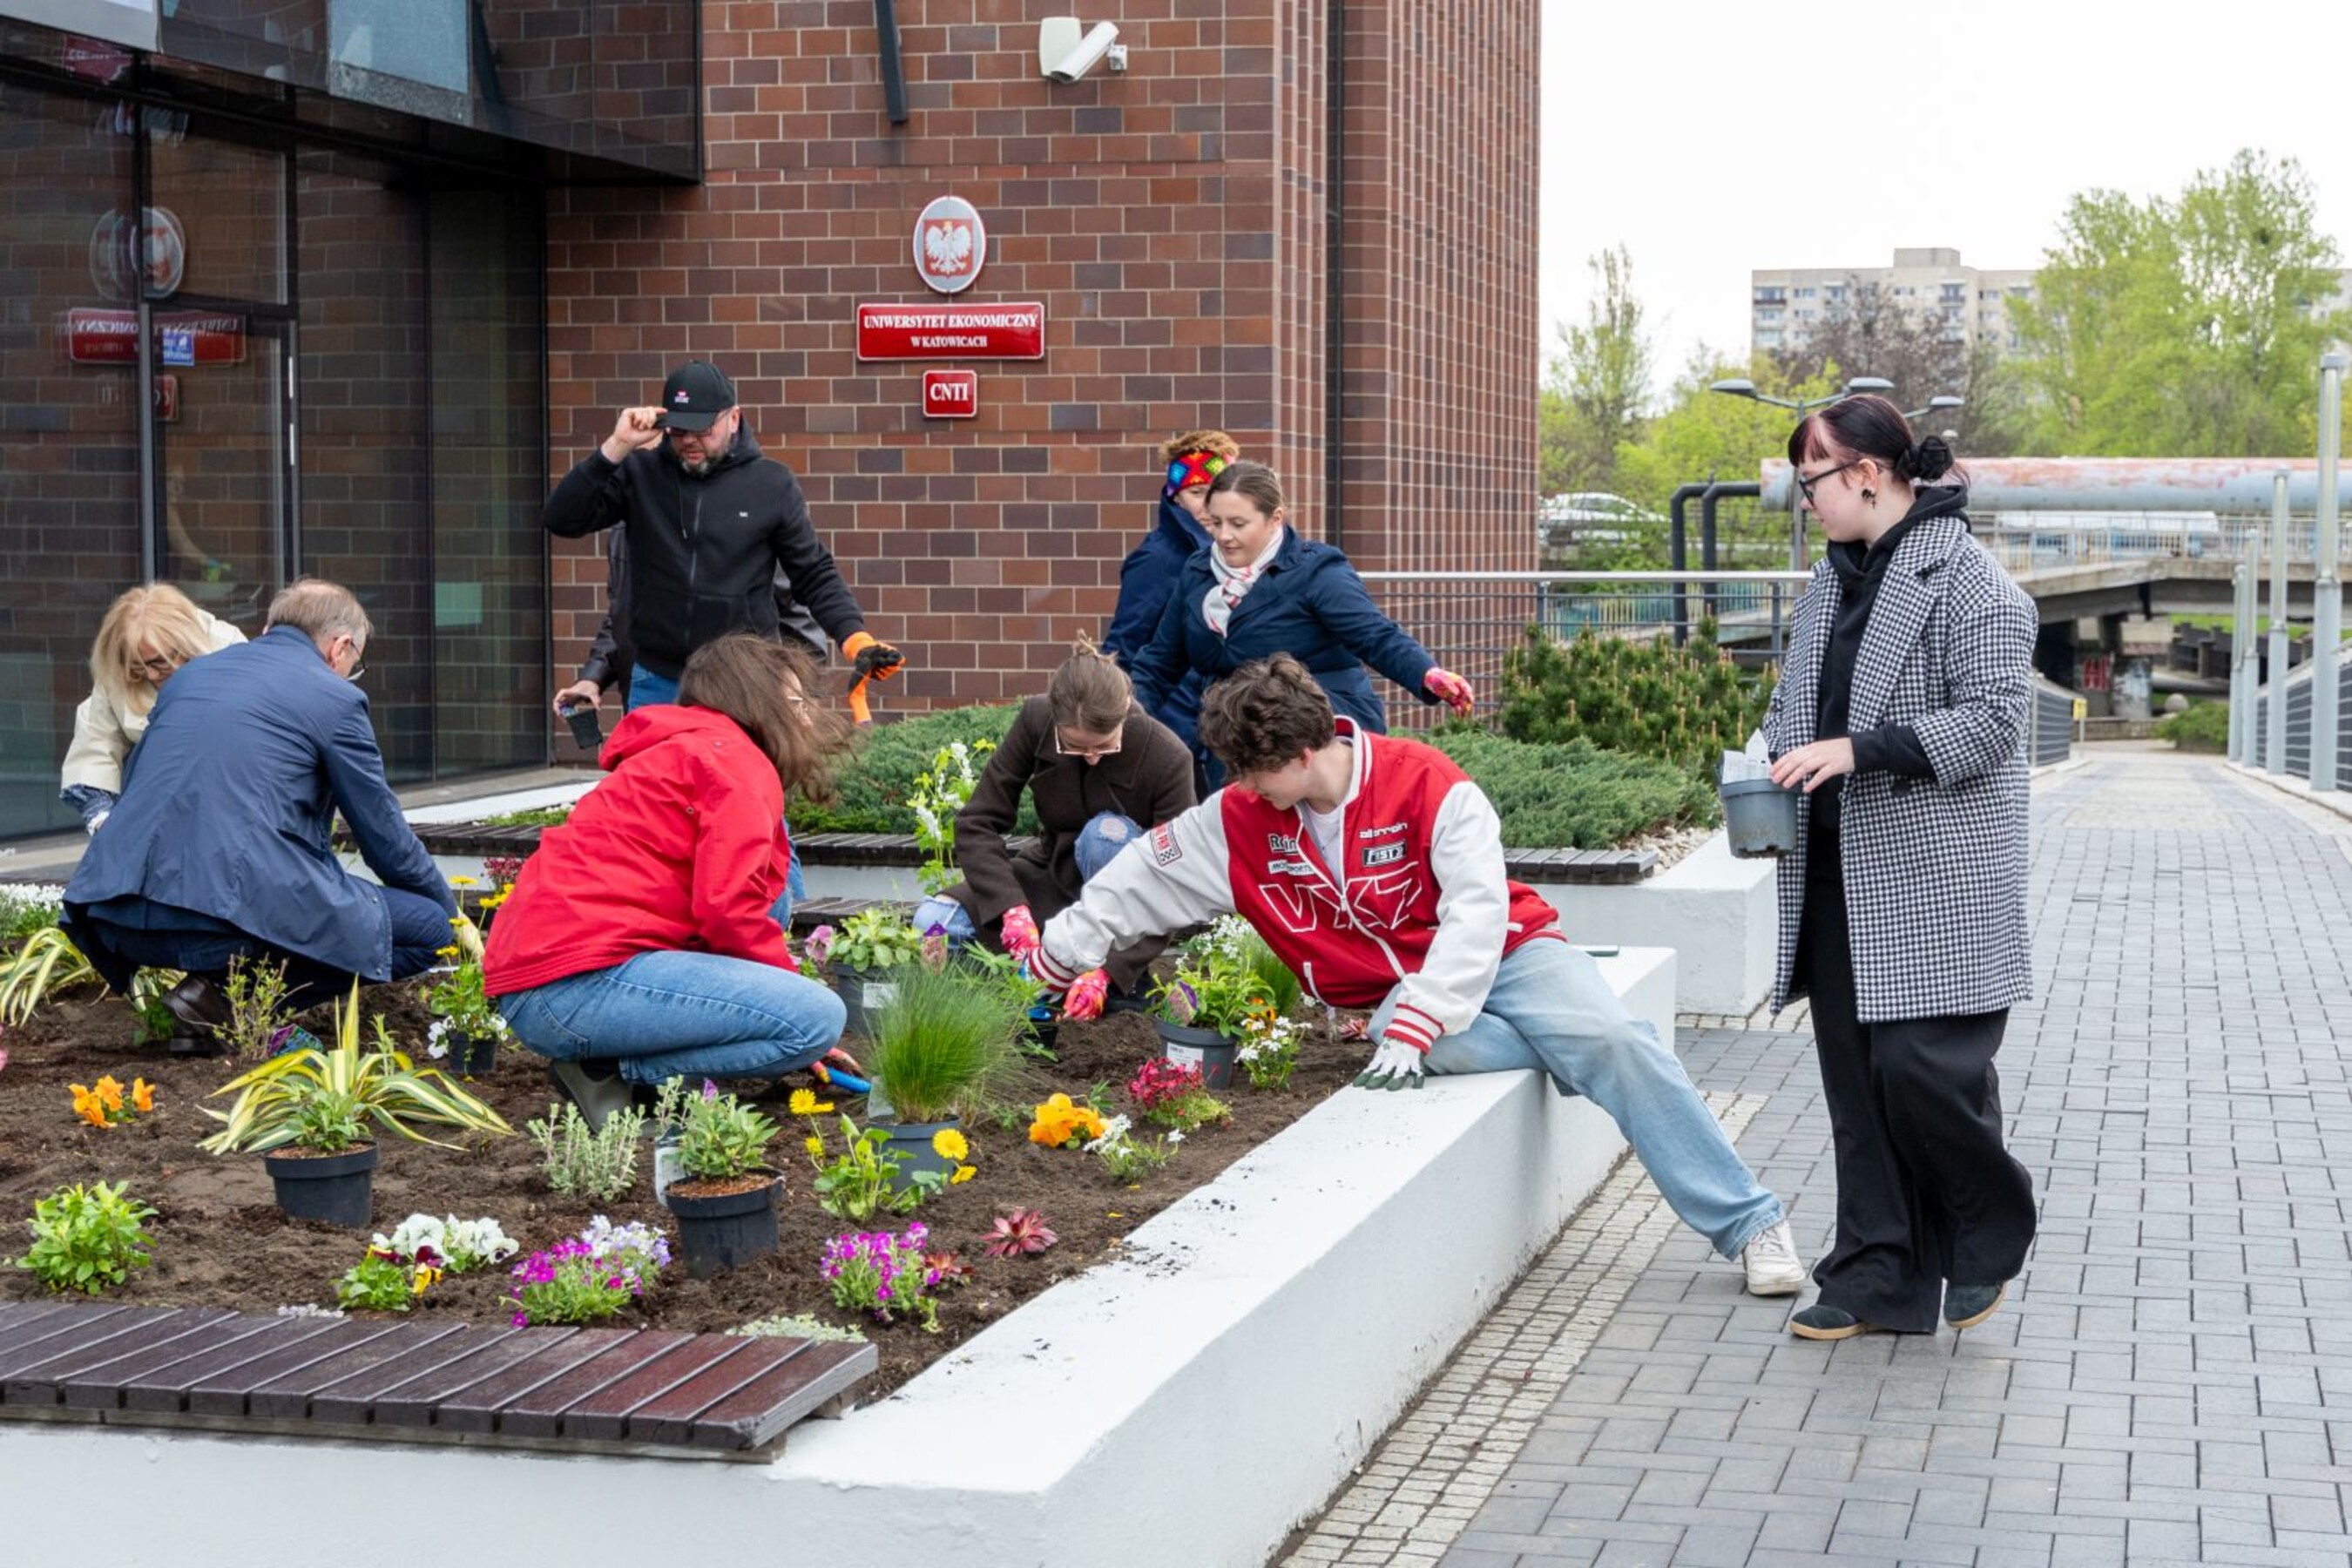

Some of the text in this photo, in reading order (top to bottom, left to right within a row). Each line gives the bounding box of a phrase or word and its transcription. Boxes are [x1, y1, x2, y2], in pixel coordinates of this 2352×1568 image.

[864, 314, 1038, 328] UNIWERSYTET EKONOMICZNY
[911, 335, 987, 348] W KATOWICACH
[929, 382, 969, 402] CNTI
